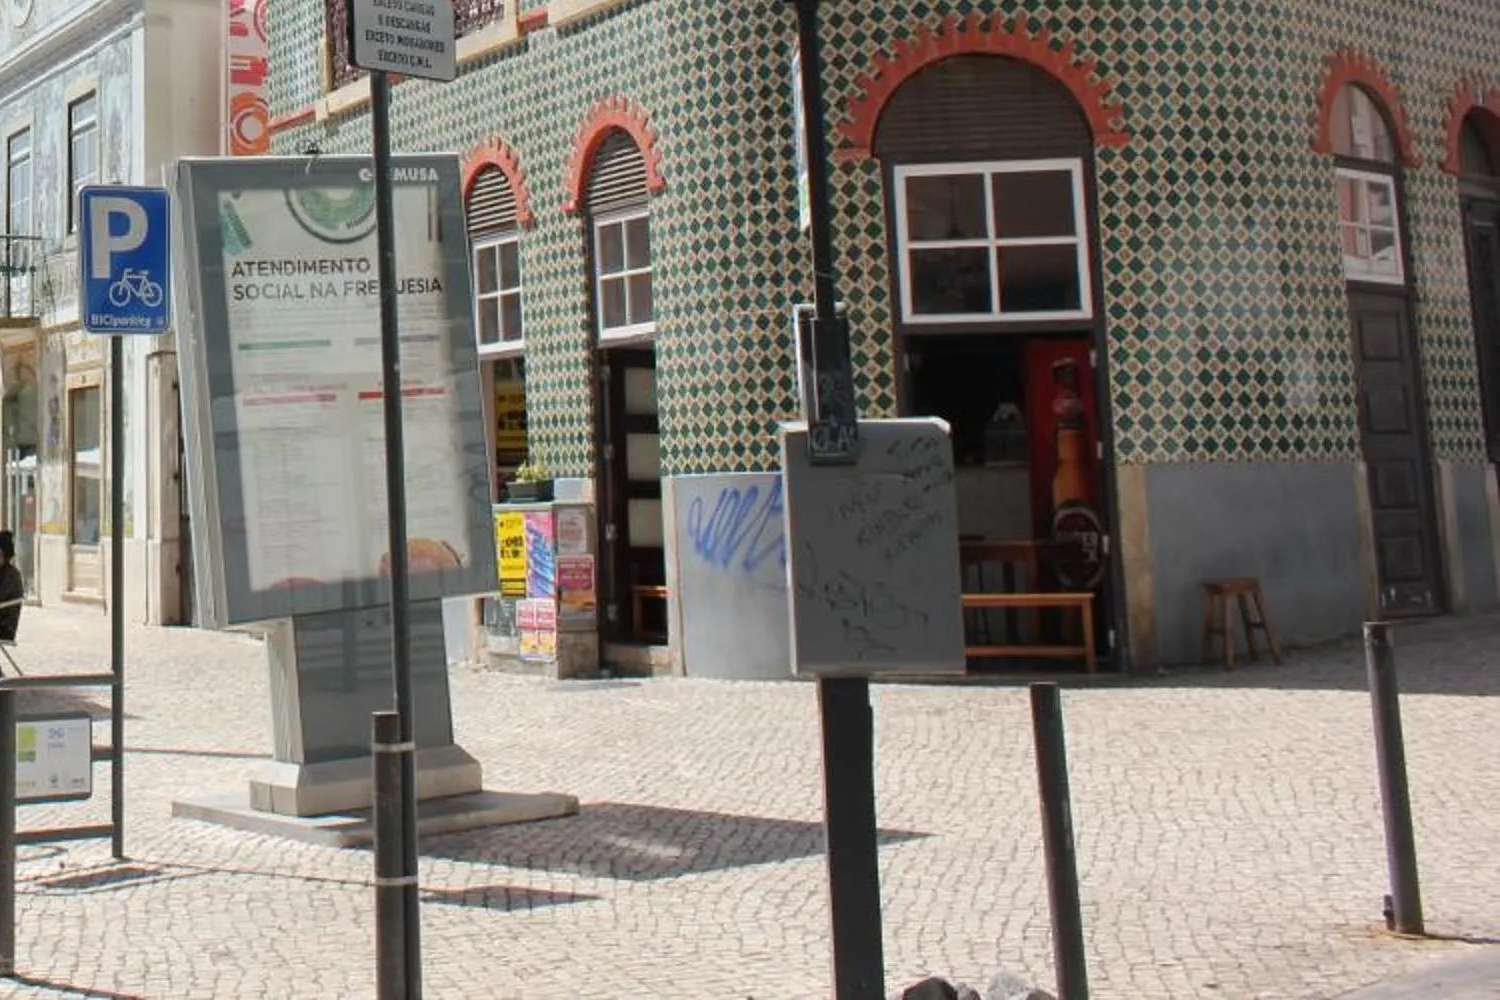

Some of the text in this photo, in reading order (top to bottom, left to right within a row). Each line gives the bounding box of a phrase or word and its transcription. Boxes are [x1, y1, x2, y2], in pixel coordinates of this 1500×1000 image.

[89, 195, 149, 279] P
[231, 257, 372, 279] ATENDIMENTO
[232, 277, 444, 302] SOCIAL NA FREUESIA
